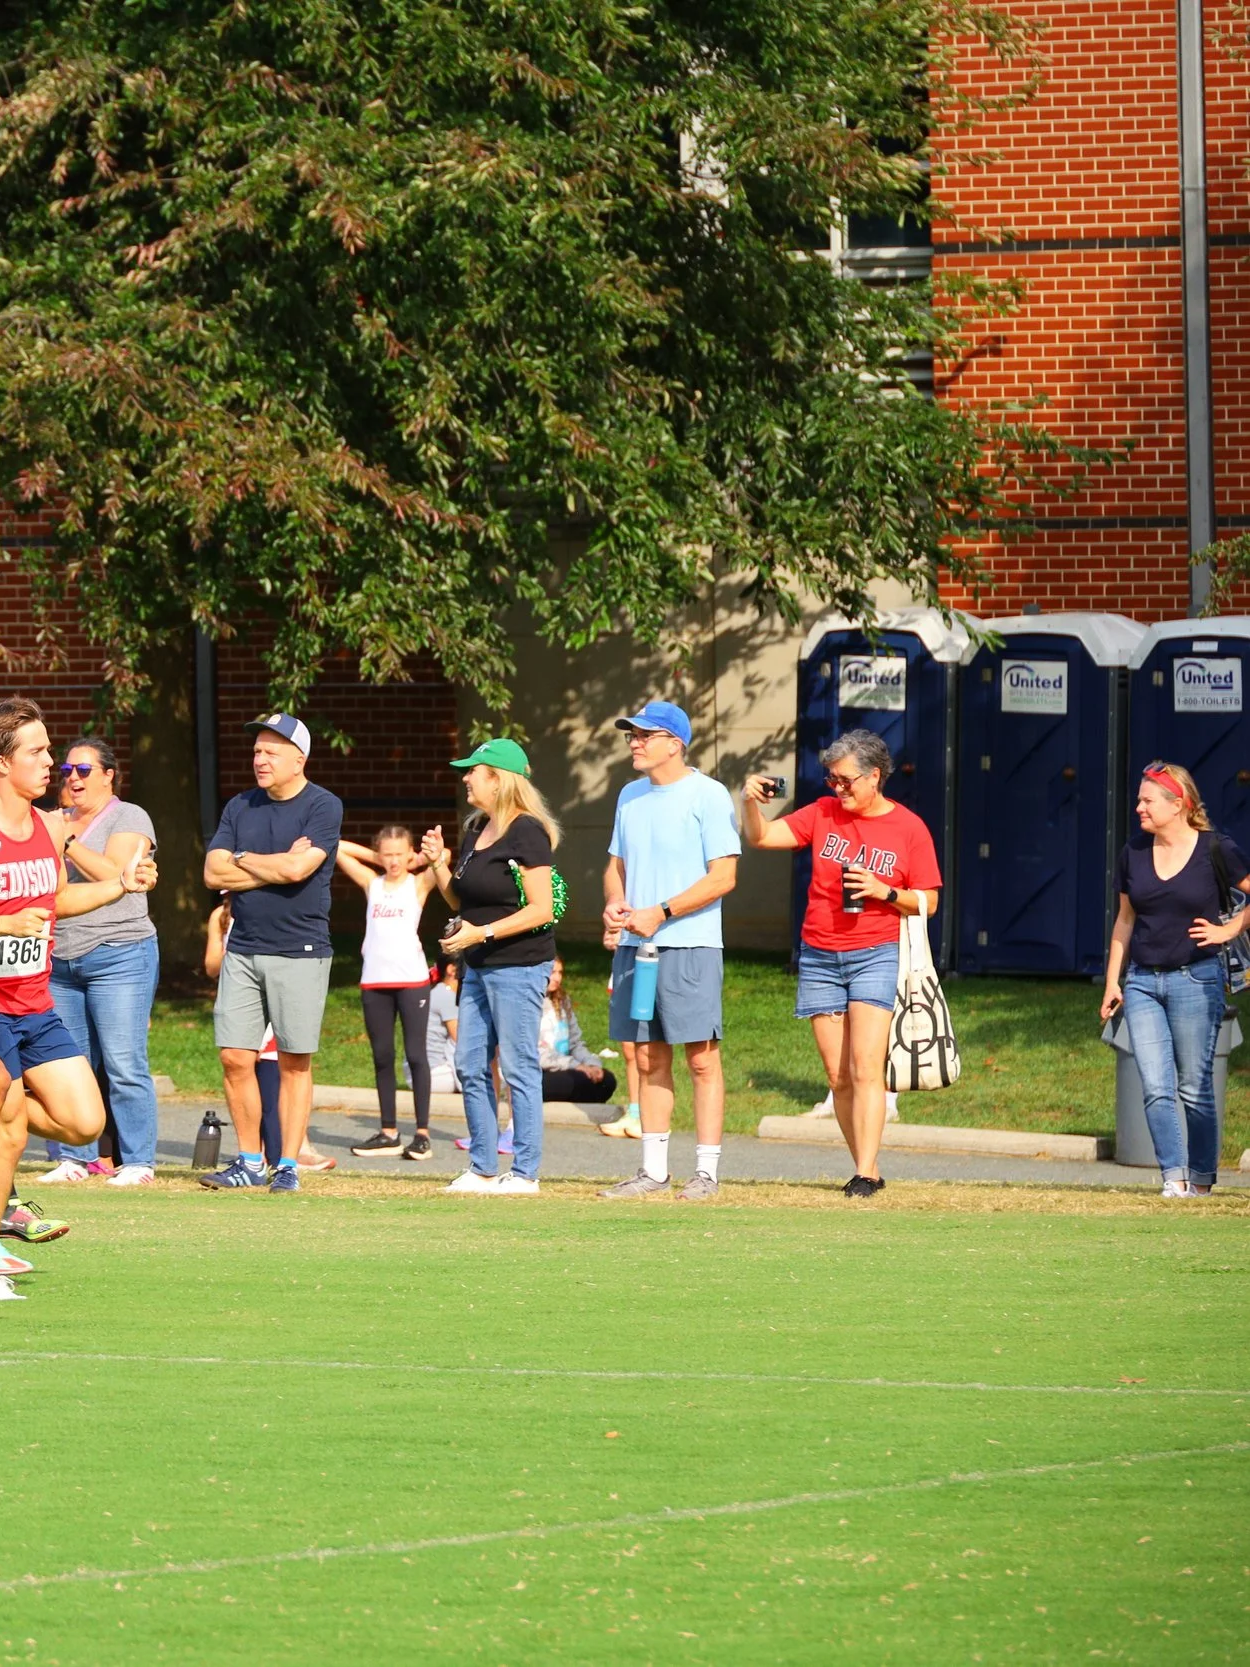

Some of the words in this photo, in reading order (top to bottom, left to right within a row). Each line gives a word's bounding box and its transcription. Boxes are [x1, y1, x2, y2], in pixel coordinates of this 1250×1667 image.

[847, 667, 901, 686] United
[1010, 671, 1063, 689] United
[1181, 669, 1234, 685] United
[819, 832, 898, 878] BLAIR
[372, 903, 404, 919] Blair
